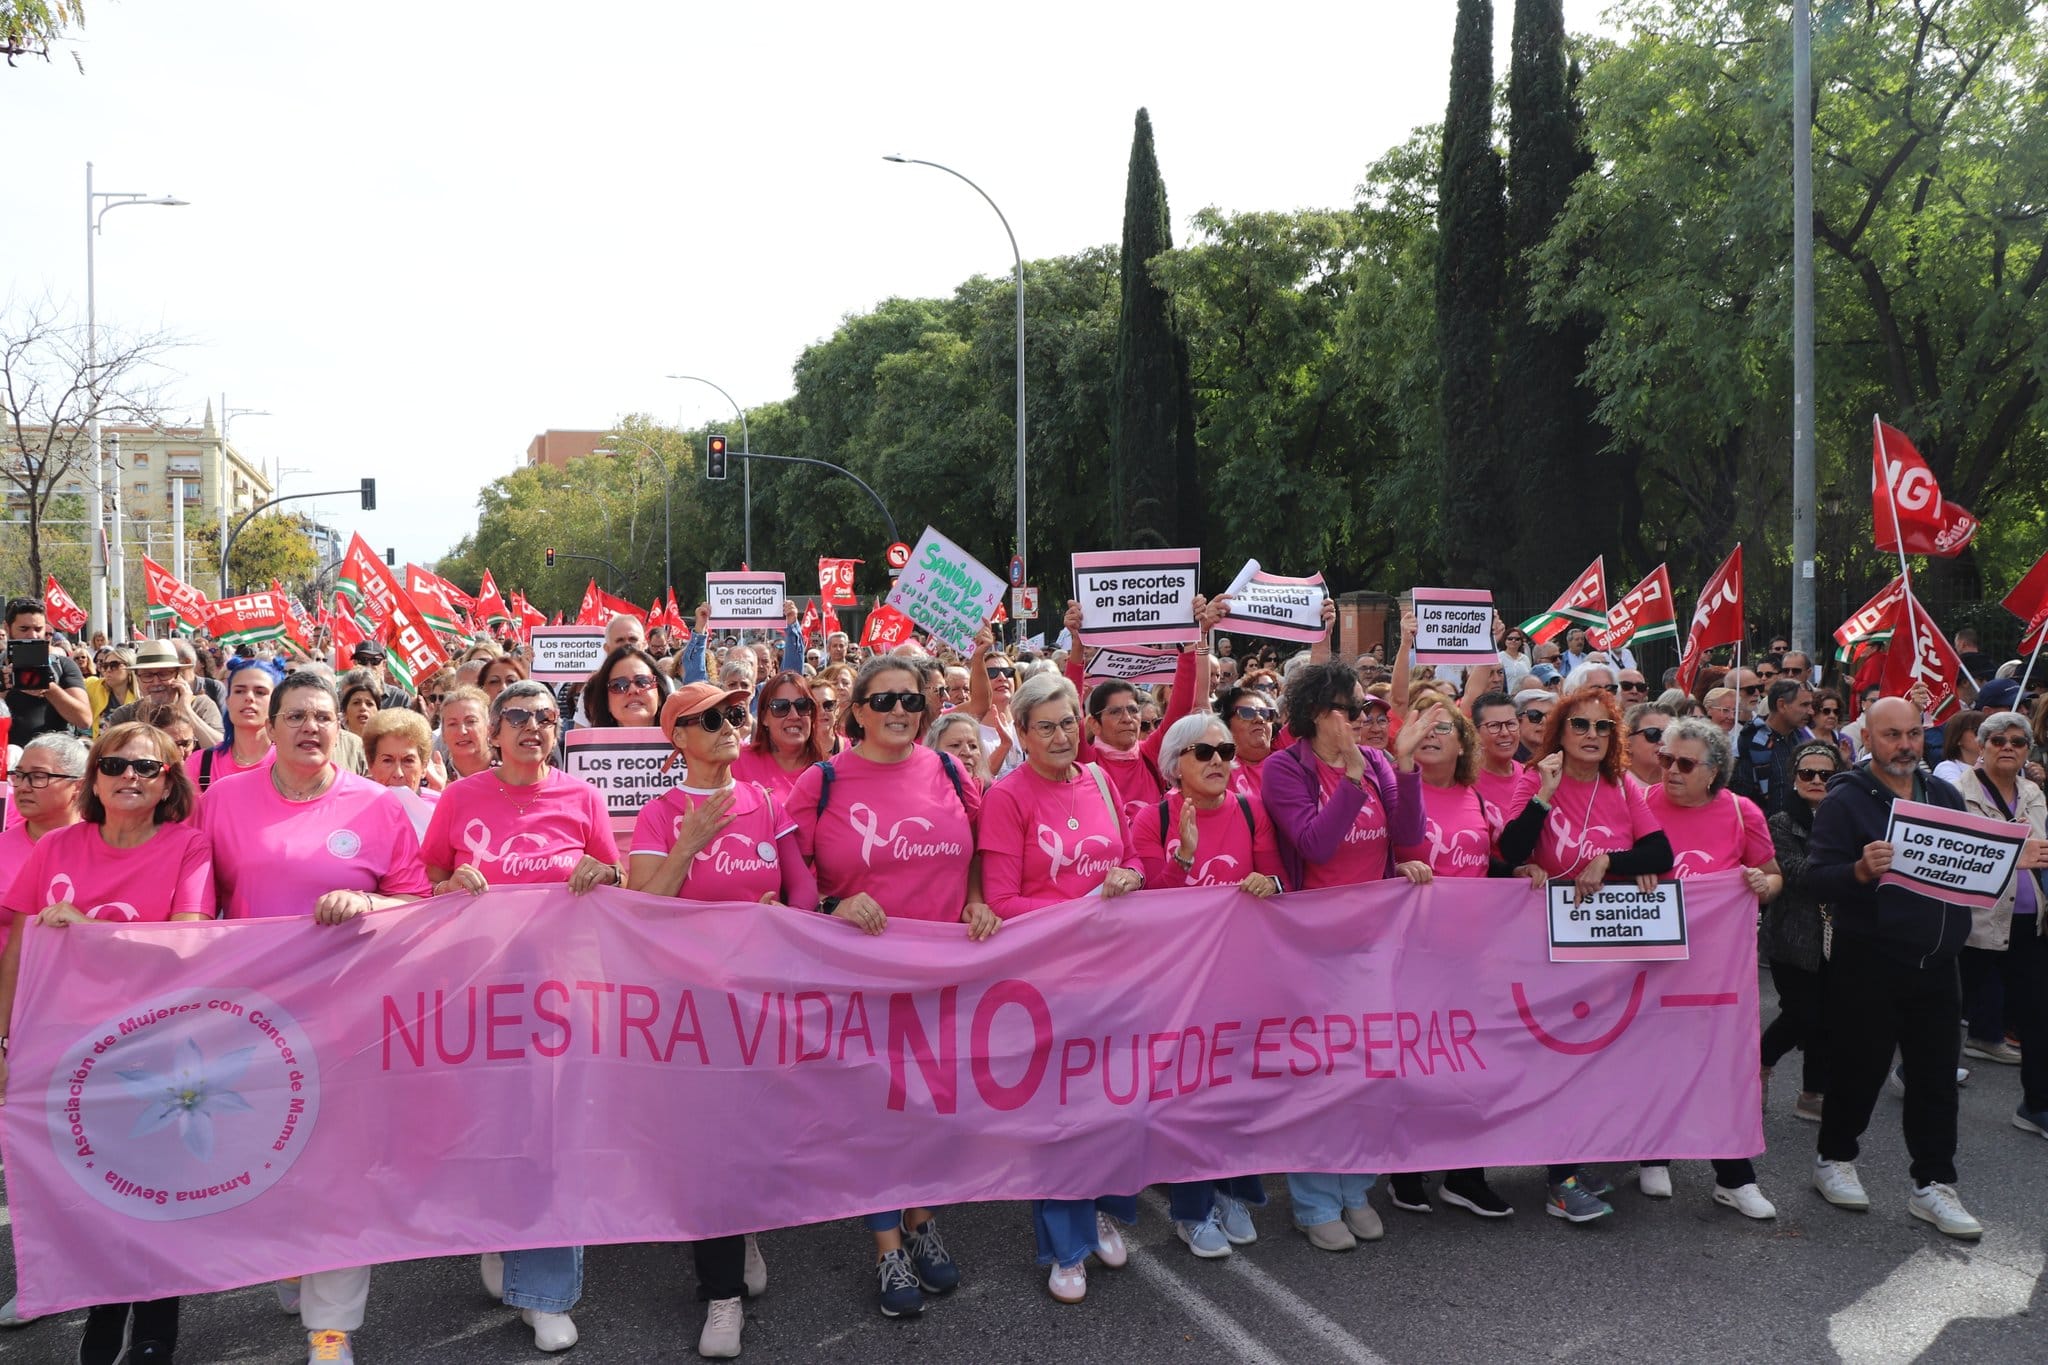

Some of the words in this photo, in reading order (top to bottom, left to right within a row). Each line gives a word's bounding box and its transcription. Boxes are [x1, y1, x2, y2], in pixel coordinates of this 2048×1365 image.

[716, 587, 734, 595] Los
[737, 587, 777, 595] recortes
[1089, 577, 1118, 591] Los
[1122, 575, 1185, 589] recortes
[735, 596, 773, 605] sanidad
[1096, 596, 1114, 608] en
[1118, 590, 1179, 606] sanidad
[1251, 595, 1309, 606] sanidad
[237, 607, 275, 621] Sevilla
[732, 607, 762, 615] matan
[1112, 609, 1160, 623] matan
[1248, 604, 1293, 618] matan
[1424, 608, 1442, 620] Los
[1445, 610, 1486, 621] recortes
[908, 602, 968, 652] CONFIAR
[1426, 623, 1439, 633] en
[1441, 623, 1481, 634] sanidad
[540, 640, 558, 649] Los
[561, 641, 601, 649] recortes
[1437, 636, 1468, 647] matan
[558, 650, 597, 658] sanidad
[578, 755, 612, 771] Los
[613, 772, 684, 788] sanidad
[893, 836, 963, 861] Amama
[1903, 828, 1933, 846] Los
[1937, 837, 2006, 860] recortes
[1902, 849, 1925, 861] en
[1927, 851, 1995, 874] sanidad
[1913, 865, 1967, 885] matan
[1563, 890, 1594, 904] Ls
[1570, 909, 1590, 921] en
[1595, 906, 1661, 920] sanidad
[1591, 924, 1643, 938] matan
[207, 999, 244, 1017] con
[118, 1002, 202, 1036] Mujeres
[93, 1034, 117, 1055] de
[248, 1011, 297, 1066] Cáncer
[382, 979, 711, 1071] NUESTRA
[727, 990, 876, 1066] VIDA
[887, 978, 1054, 1116] NO
[1059, 1020, 1241, 1107] PUEDE
[1252, 1009, 1487, 1081] ESPERAR
[289, 1070, 305, 1093] de
[64, 1057, 97, 1158] Asociación
[272, 1098, 305, 1152] Mama
[104, 1170, 169, 1204] Sevilla
[175, 1171, 251, 1203] Amama
